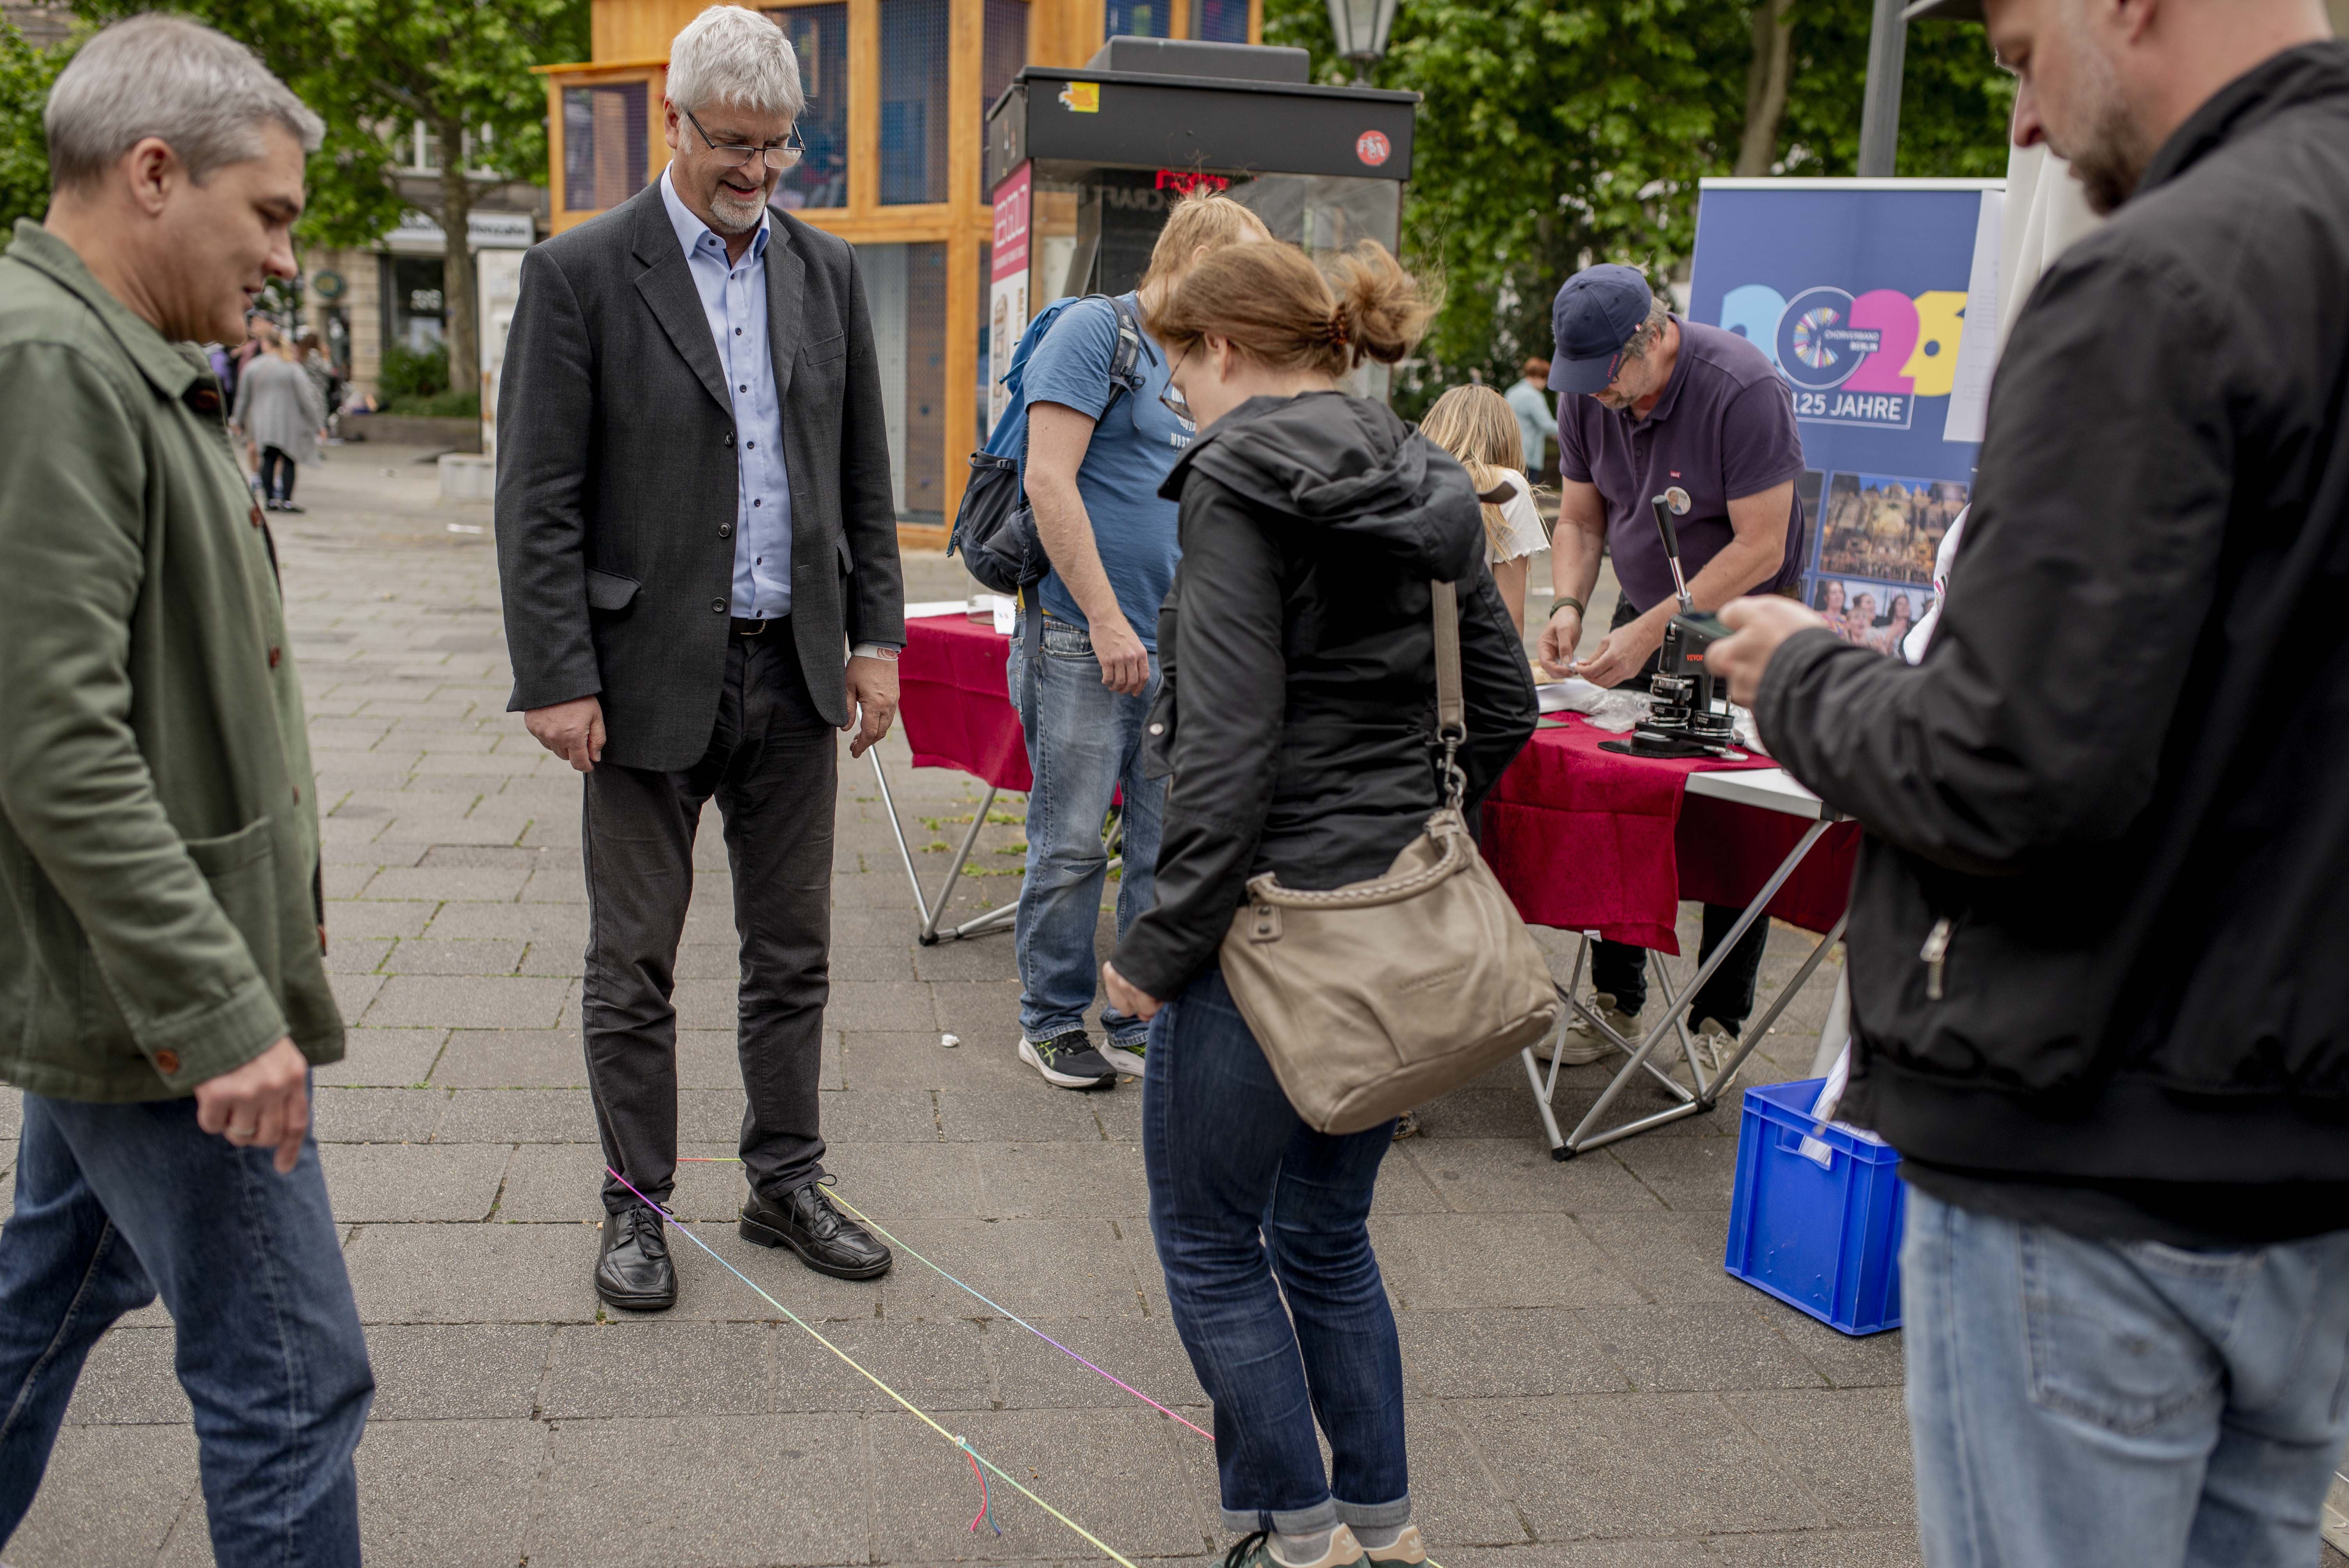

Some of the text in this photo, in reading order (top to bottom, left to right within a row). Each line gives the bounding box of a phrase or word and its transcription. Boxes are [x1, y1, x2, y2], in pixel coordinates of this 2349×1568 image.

[1824, 330, 1880, 341] CHORVERBAND
[1850, 342, 1878, 351] BERLIN
[1829, 394, 1903, 421] JAHRE
